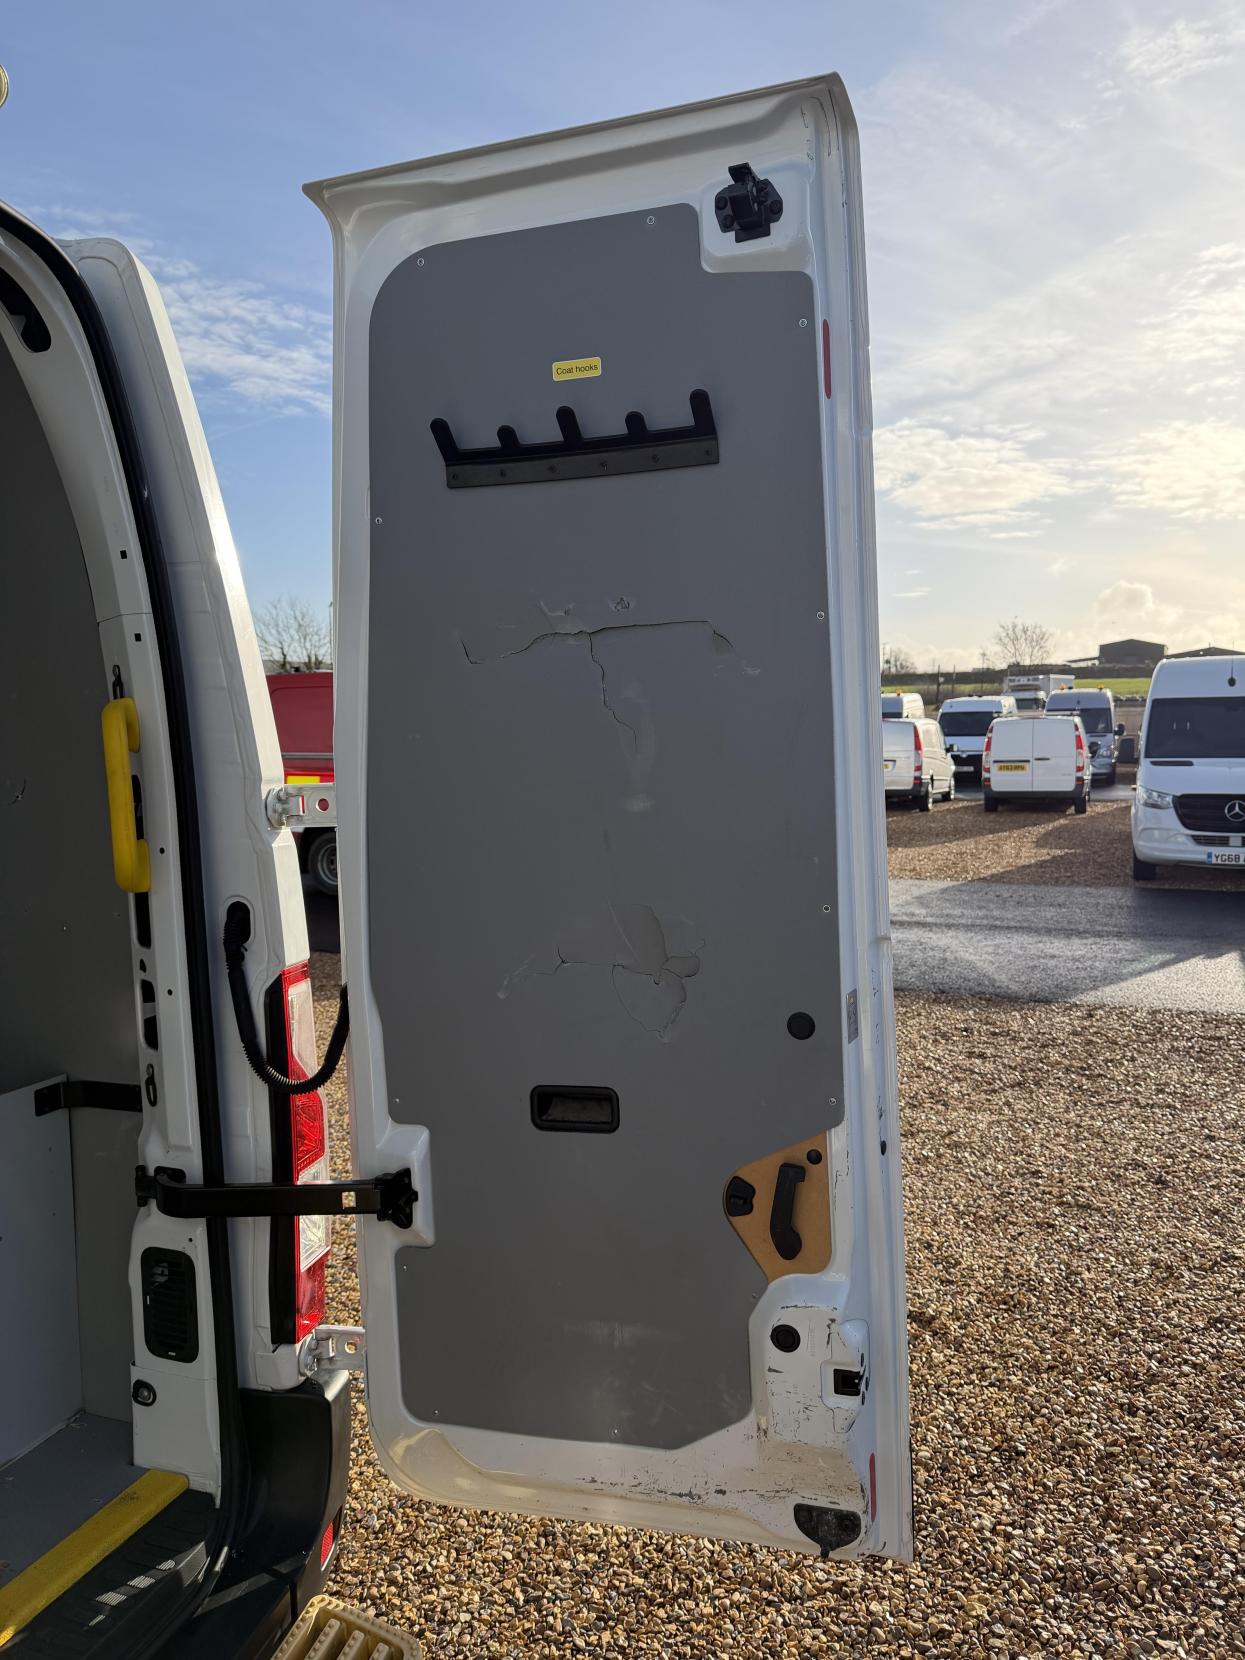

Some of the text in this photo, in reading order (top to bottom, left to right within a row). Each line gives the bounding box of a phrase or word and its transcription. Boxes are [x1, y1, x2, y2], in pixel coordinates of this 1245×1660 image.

[556, 364, 598, 375] Coat hooks
[1214, 853, 1241, 863] YG68
